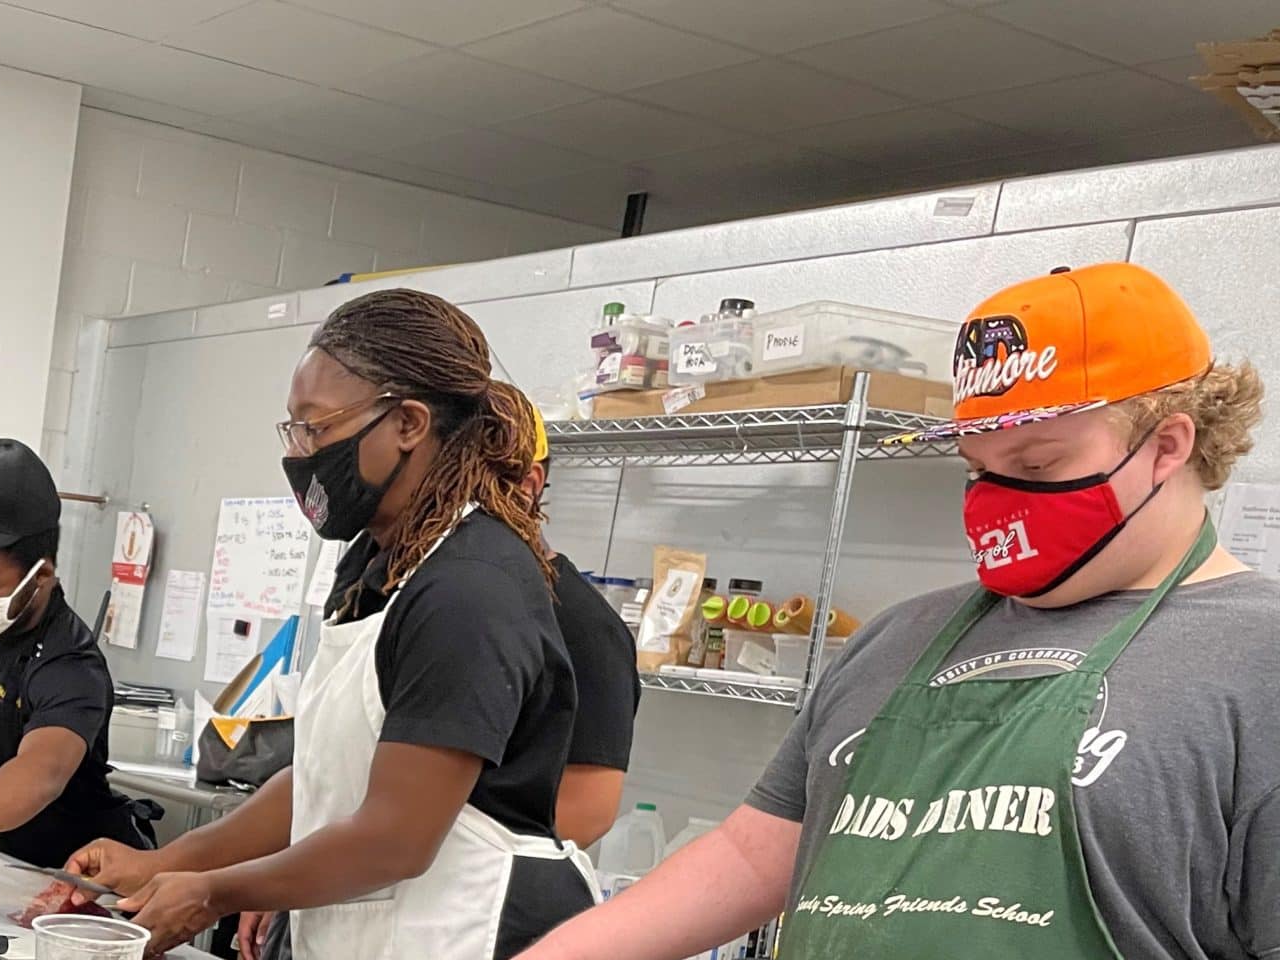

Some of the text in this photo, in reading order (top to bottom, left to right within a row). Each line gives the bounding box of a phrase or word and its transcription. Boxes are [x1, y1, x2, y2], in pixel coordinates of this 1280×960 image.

[984, 655, 1001, 666] OF
[1008, 649, 1077, 661] COLORADO
[829, 793, 915, 841] DADS
[820, 895, 878, 920] Spring
[883, 894, 968, 917] Friends
[972, 897, 1054, 927] School
